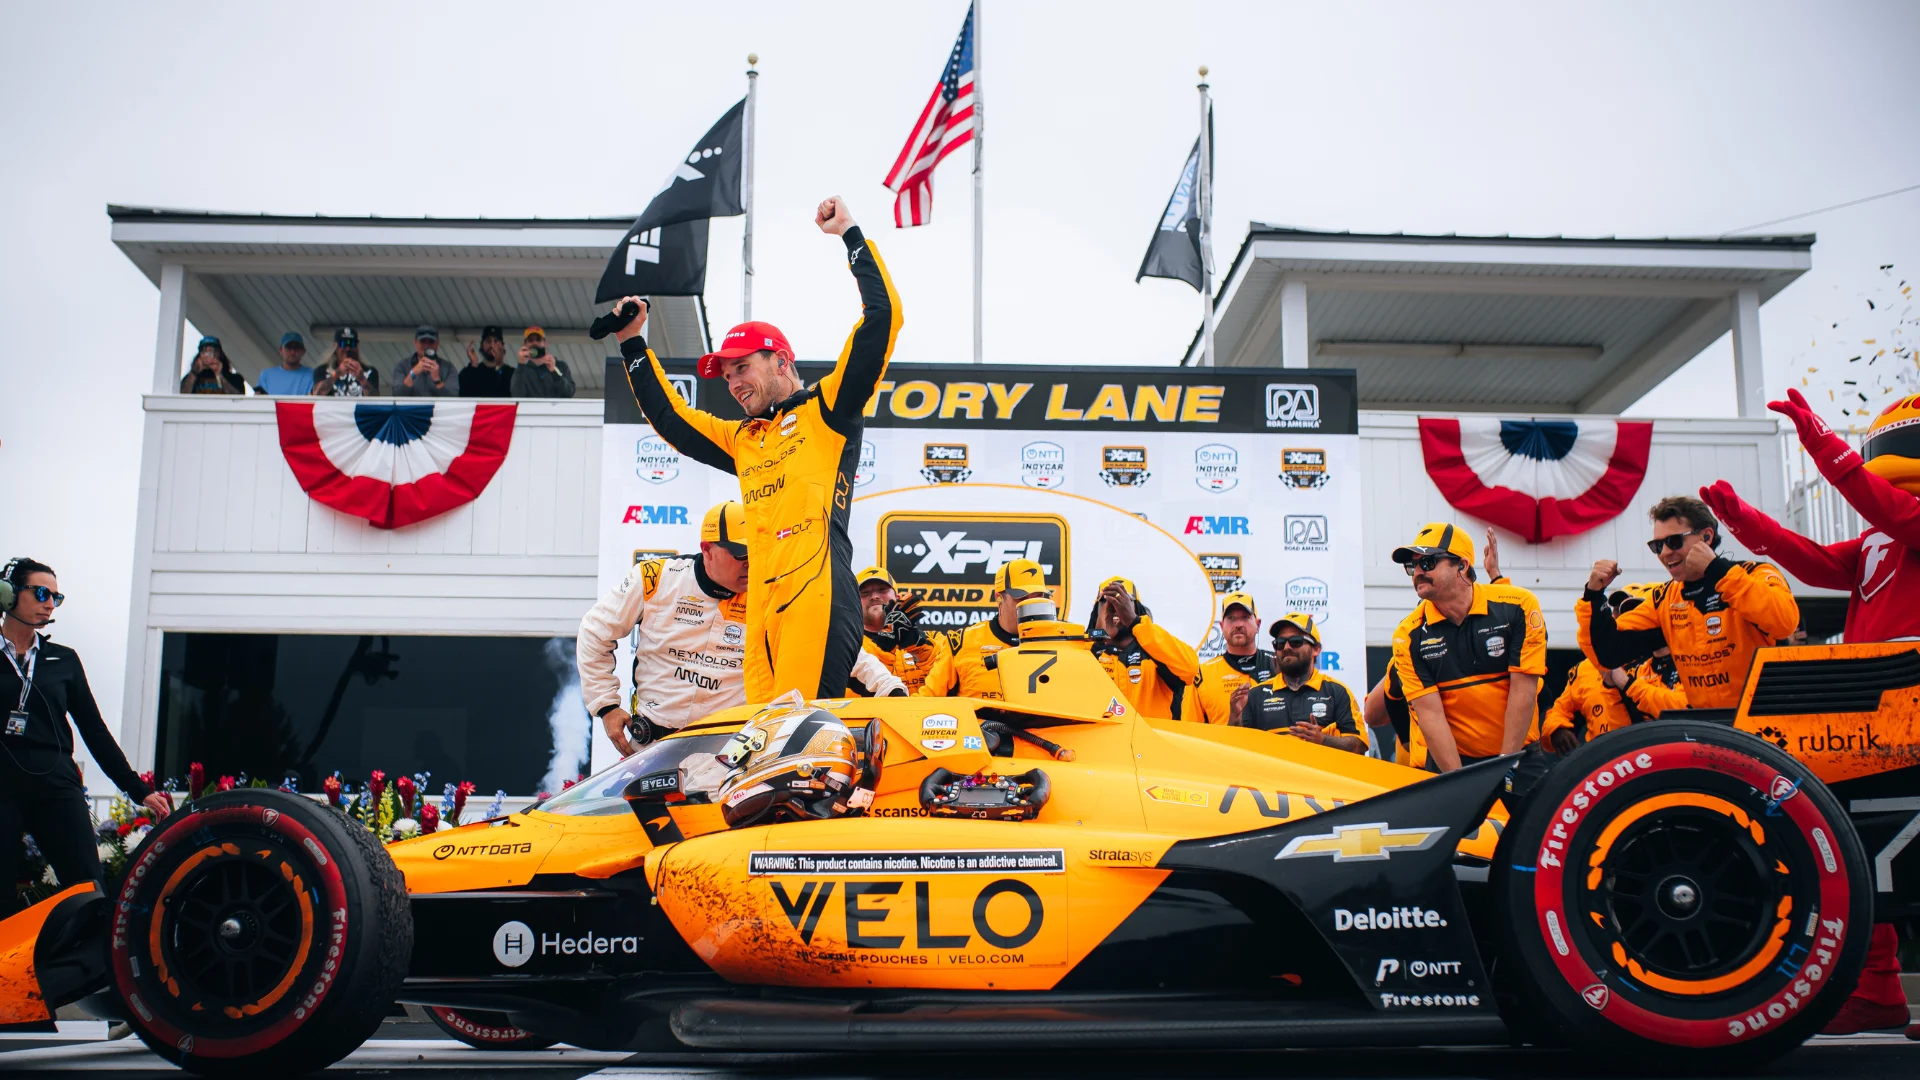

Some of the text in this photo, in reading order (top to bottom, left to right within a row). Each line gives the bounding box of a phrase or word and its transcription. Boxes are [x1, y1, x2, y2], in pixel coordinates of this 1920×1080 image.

[1045, 383, 1225, 422] LANE
[1288, 420, 1319, 428] AMERICA
[931, 447, 965, 459] XPEL
[1038, 450, 1059, 458] NTT
[1110, 450, 1144, 461] XPEL
[1211, 453, 1232, 461] NTT
[1290, 452, 1322, 464] XPEL
[834, 471, 849, 510] CL7
[622, 505, 688, 525] AMR
[791, 520, 813, 535] CL7
[1184, 516, 1249, 535] AMR
[912, 531, 1053, 574] XPEL
[1302, 586, 1323, 595] NTT
[922, 611, 968, 625] ROAD
[669, 648, 737, 668] REYNOLDS
[1674, 649, 1730, 662] REYNOLDS
[674, 666, 722, 690] ARROW
[1018, 650, 1057, 693] 7
[936, 719, 955, 727] NTT
[964, 736, 981, 749] PPG
[1799, 724, 1881, 751] rubrik
[649, 777, 676, 788] VELO
[733, 791, 745, 800] BELL
[1541, 752, 1653, 869] Firestone
[456, 843, 532, 856] NTT DATA
[1089, 848, 1152, 863] stratasys
[755, 854, 1058, 872] WARNING: This product contains nicotine. Nicotine is an addictive chemical.
[113, 841, 165, 949] Firestone
[769, 878, 1044, 950] VELO
[1334, 906, 1448, 931] Deloitte.
[542, 931, 638, 955] Hedera
[293, 907, 347, 1020] Firestone
[860, 954, 928, 964] POUCHES
[949, 954, 1024, 964] VELO.COM
[1429, 961, 1462, 975] NTT
[1728, 917, 1845, 1038] Firestone
[1380, 992, 1480, 1007] Firestone
